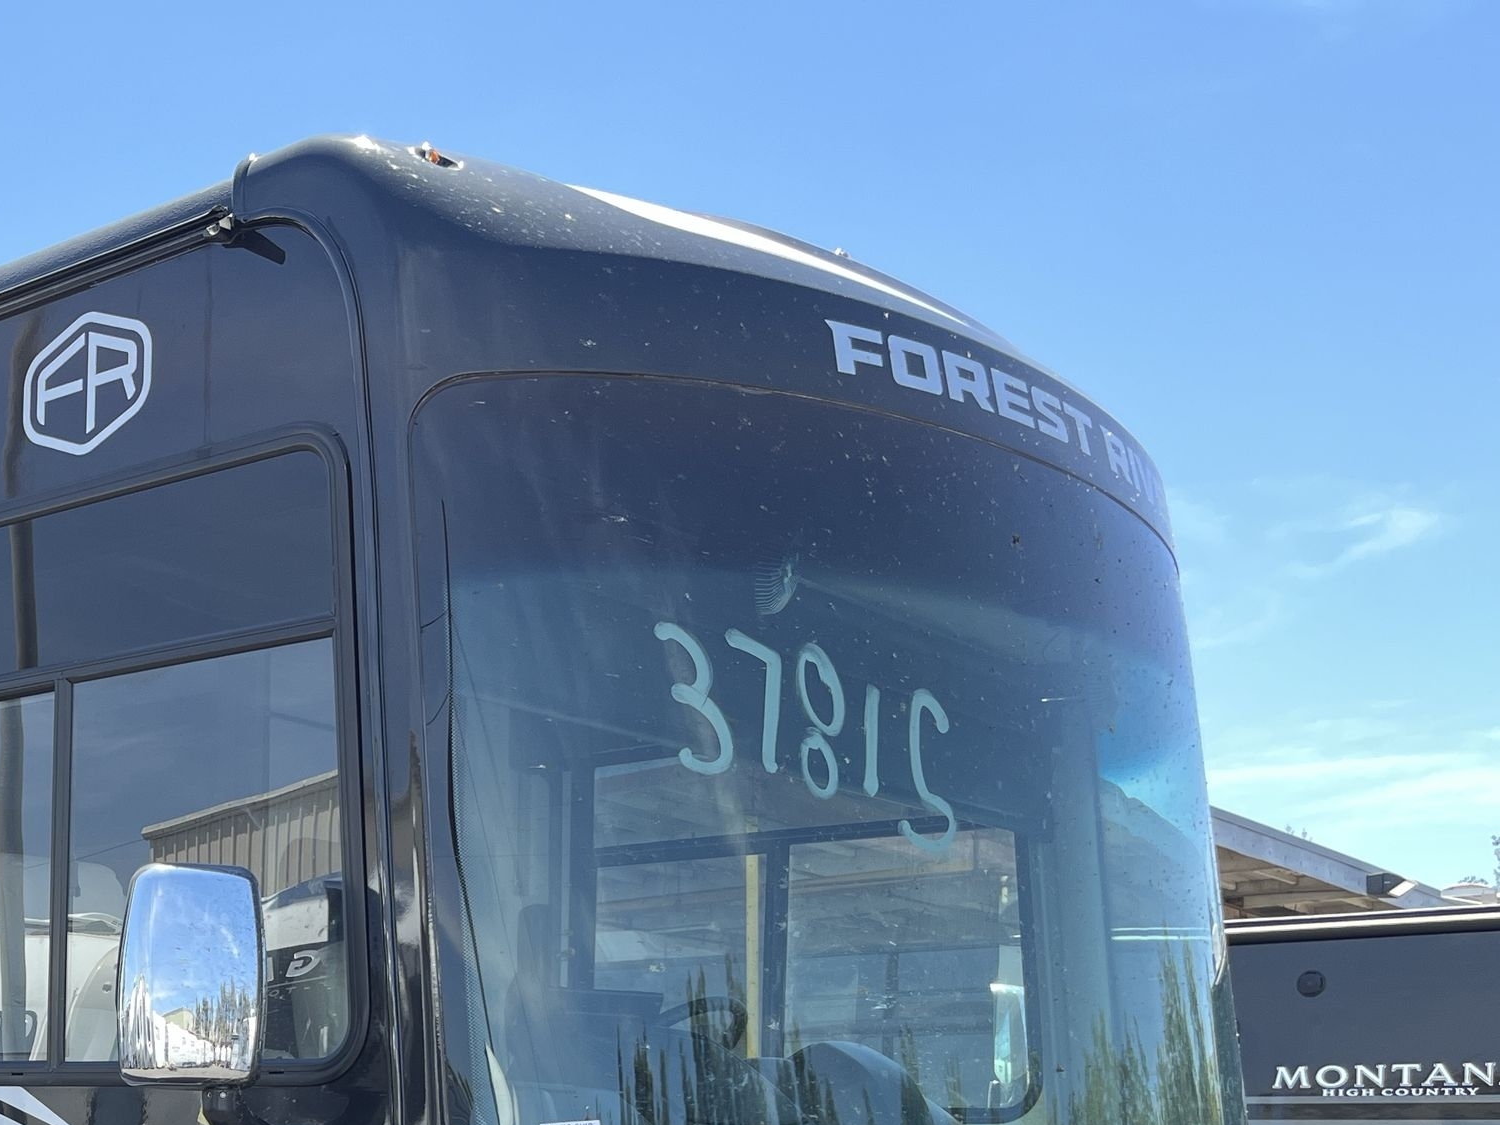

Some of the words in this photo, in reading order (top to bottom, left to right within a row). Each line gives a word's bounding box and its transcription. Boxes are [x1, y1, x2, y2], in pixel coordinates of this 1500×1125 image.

[824, 319, 1093, 457] FOREST
[1271, 1062, 1500, 1090] MONTAN
[1322, 1088, 1375, 1097] HIGH
[1381, 1086, 1481, 1097] COUNTRY
